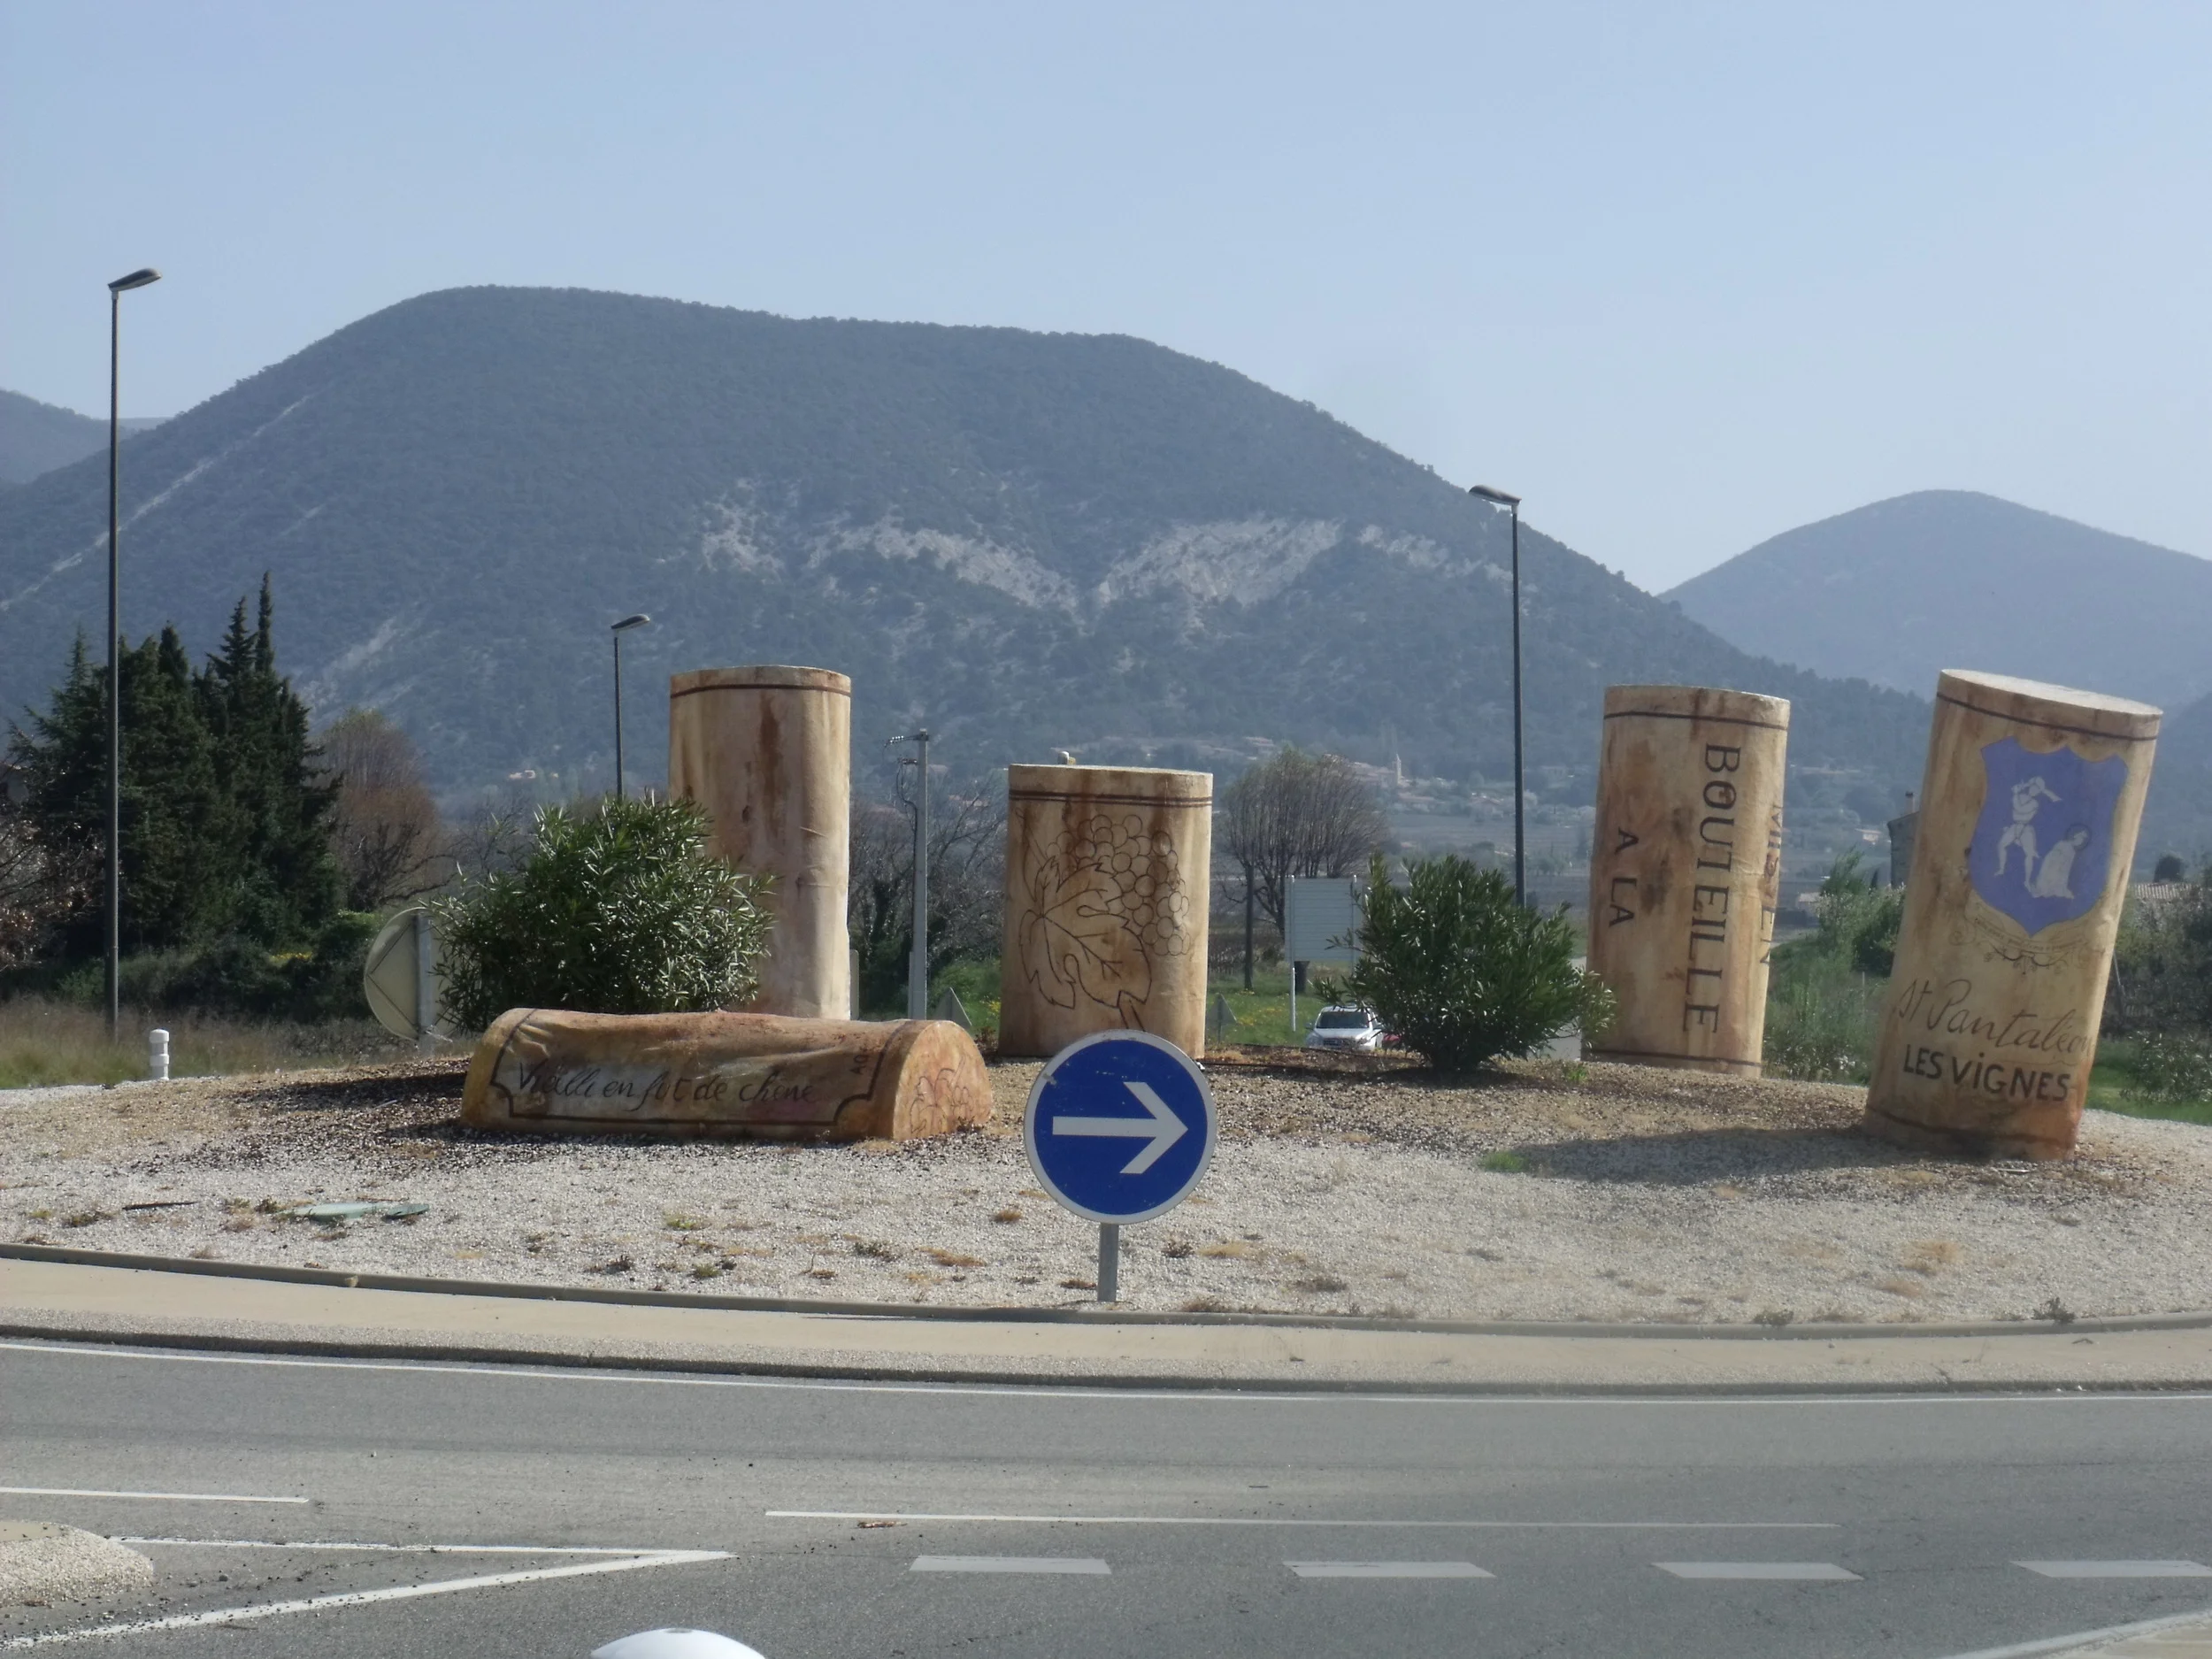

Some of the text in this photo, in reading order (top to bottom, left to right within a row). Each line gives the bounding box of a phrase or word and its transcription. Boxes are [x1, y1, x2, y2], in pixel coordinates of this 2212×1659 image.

[1609, 826, 1640, 927] A LA
[1683, 742, 1741, 1033] BOUTEILLE
[602, 1079, 636, 1098] en
[693, 1074, 728, 1102] de
[1903, 1044, 1945, 1079] LES
